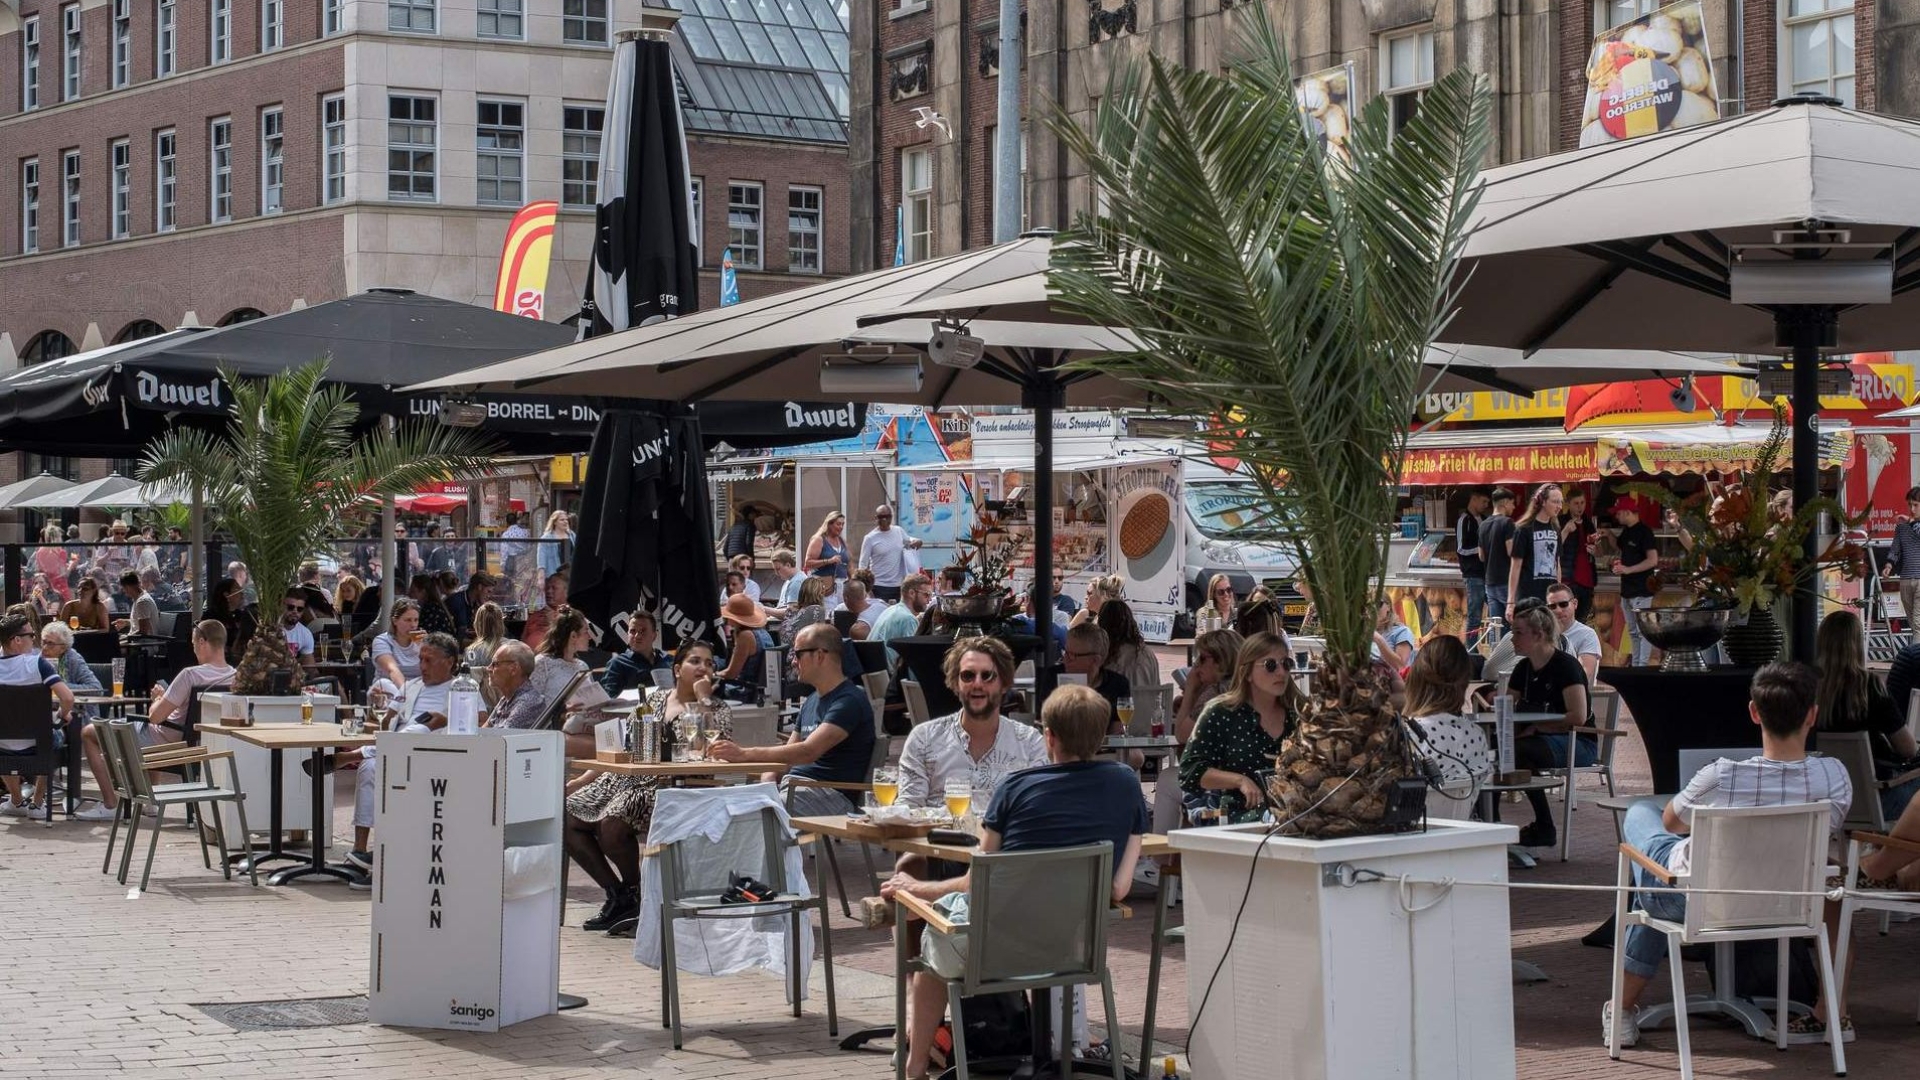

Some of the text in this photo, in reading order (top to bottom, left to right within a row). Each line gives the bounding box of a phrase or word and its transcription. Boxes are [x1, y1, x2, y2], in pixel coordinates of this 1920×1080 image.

[136, 369, 222, 408] Duvel
[1850, 373, 1906, 402] ERLOO
[409, 399, 600, 421] LUN BORREL DIN
[783, 400, 857, 429] Duvel
[942, 418, 972, 433] Kib
[1068, 415, 1112, 432] Stroopwafels
[1438, 453, 1466, 473] Friet
[1468, 451, 1504, 473] Kraam
[1508, 455, 1526, 471] van
[1530, 447, 1590, 470] Nederland
[427, 777, 448, 929] WERKMAN
[450, 1002, 495, 1021] sanigo
